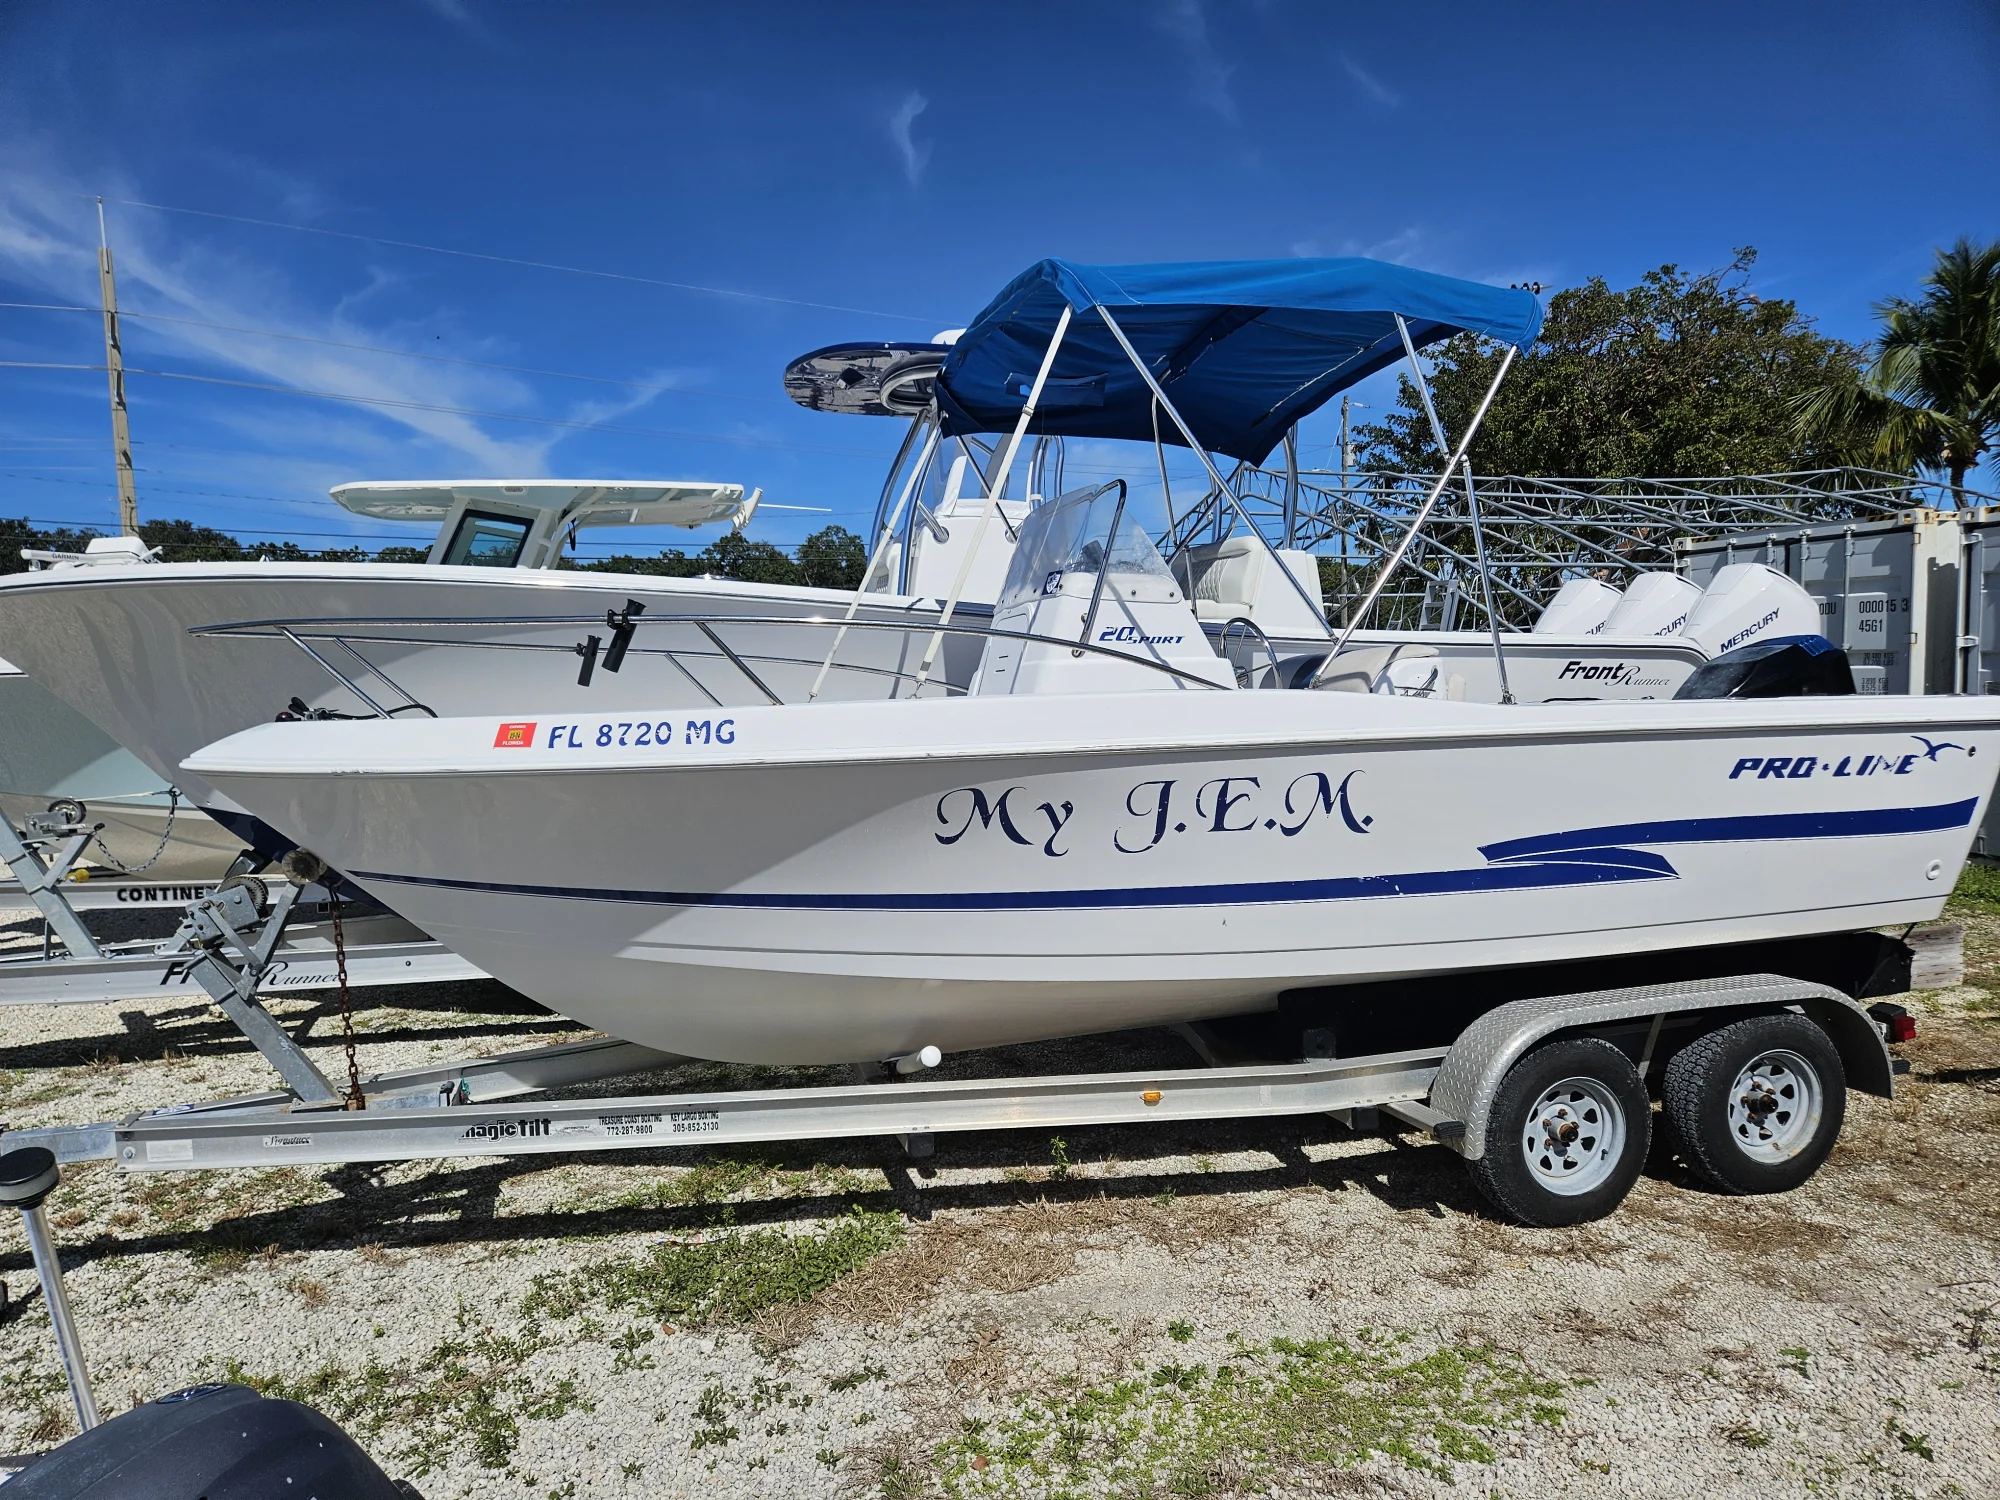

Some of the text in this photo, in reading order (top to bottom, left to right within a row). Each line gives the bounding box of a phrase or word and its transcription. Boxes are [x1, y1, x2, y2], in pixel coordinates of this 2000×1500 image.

[1859, 599, 1897, 613] 000015
[1099, 626, 1185, 645] 20 SPORT
[1720, 607, 1781, 653] MERCURY
[547, 719, 735, 749] FL 8720 MG
[934, 786, 1074, 857] My
[598, 1113, 662, 1126] TREASURE COAST BOATING
[670, 1110, 719, 1122] KEY LARGO BOATING
[606, 1124, 653, 1136] 772-287-9800
[672, 1121, 719, 1133] 305-852-3130
